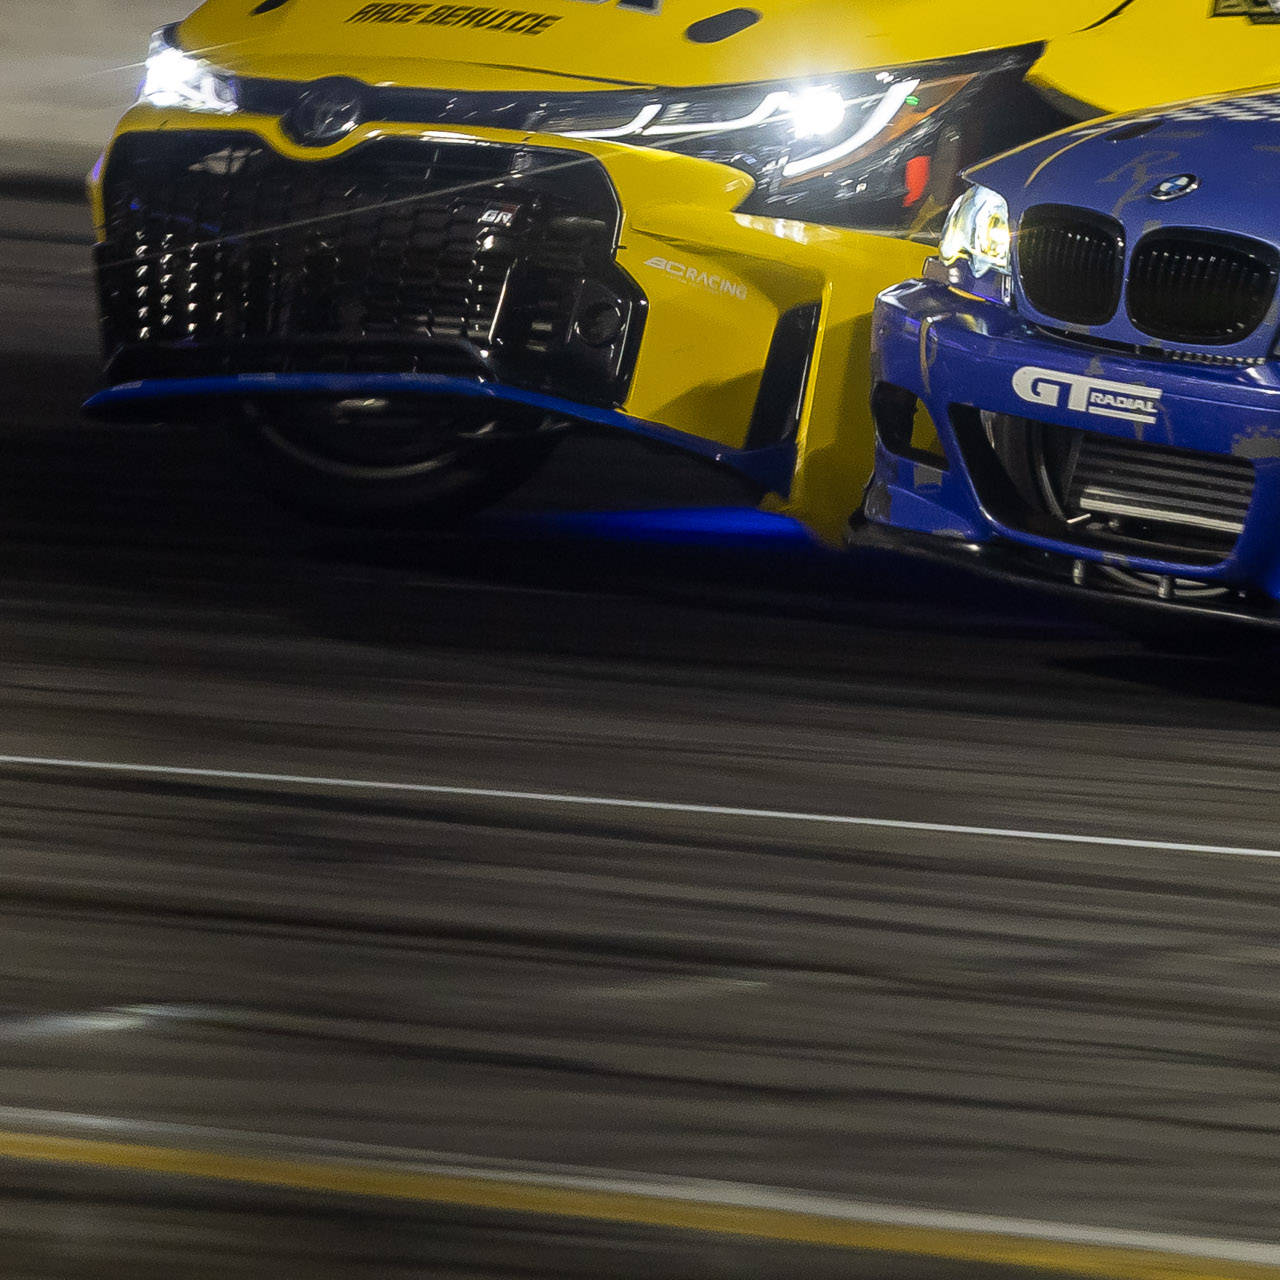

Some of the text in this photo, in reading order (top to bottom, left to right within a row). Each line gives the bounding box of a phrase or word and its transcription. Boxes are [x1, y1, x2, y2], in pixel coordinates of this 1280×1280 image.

[345, 2, 562, 36] RACE SERVICE
[686, 267, 748, 300] RACING
[1012, 366, 1162, 413] GT RADIAL
